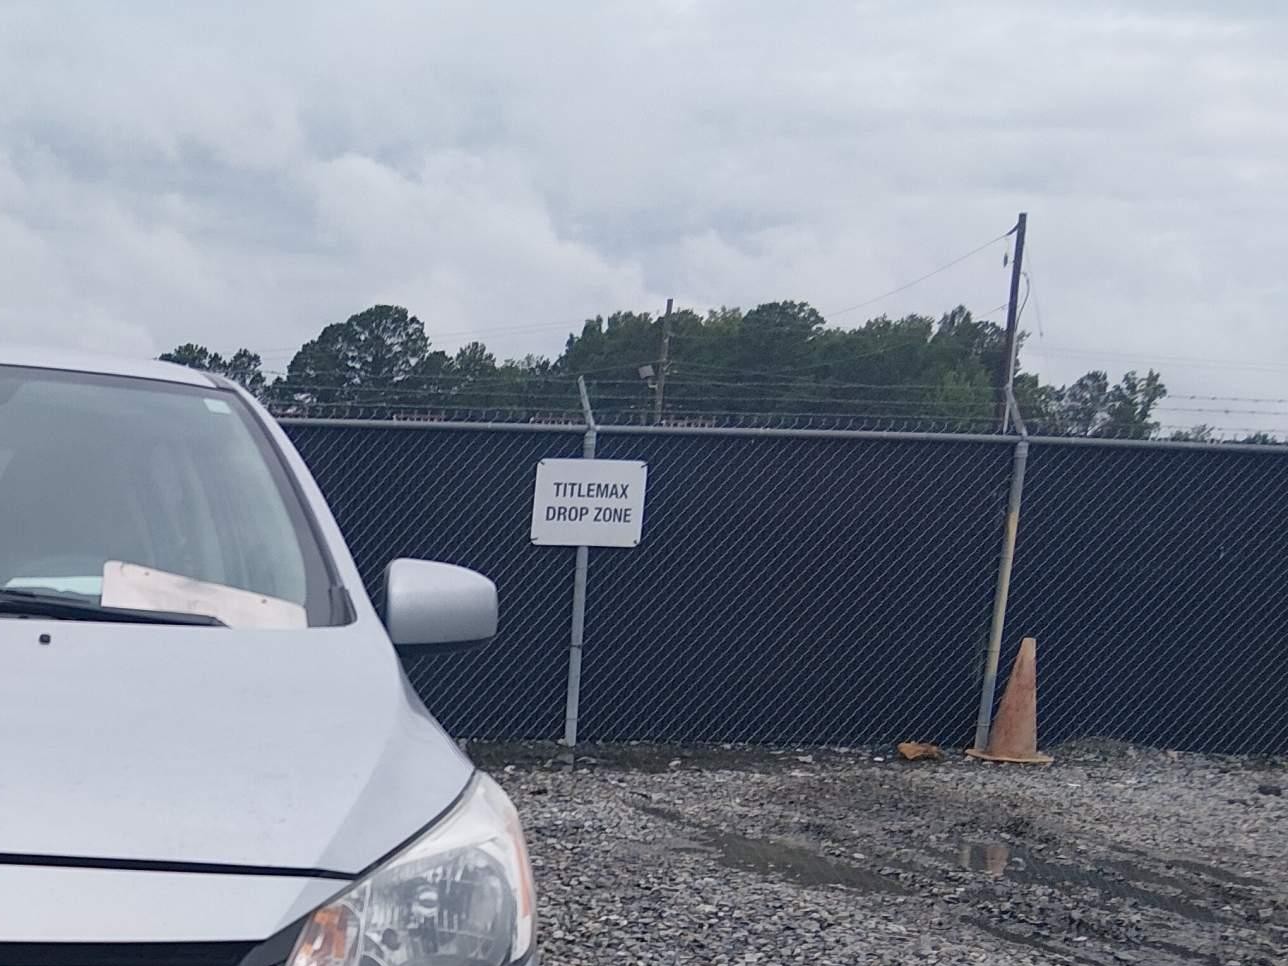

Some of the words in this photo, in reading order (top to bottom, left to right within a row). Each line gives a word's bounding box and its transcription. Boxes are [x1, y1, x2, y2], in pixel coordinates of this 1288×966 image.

[553, 482, 629, 499] TITLEMAX
[545, 506, 589, 521] DROP
[593, 507, 632, 523] ZONE
